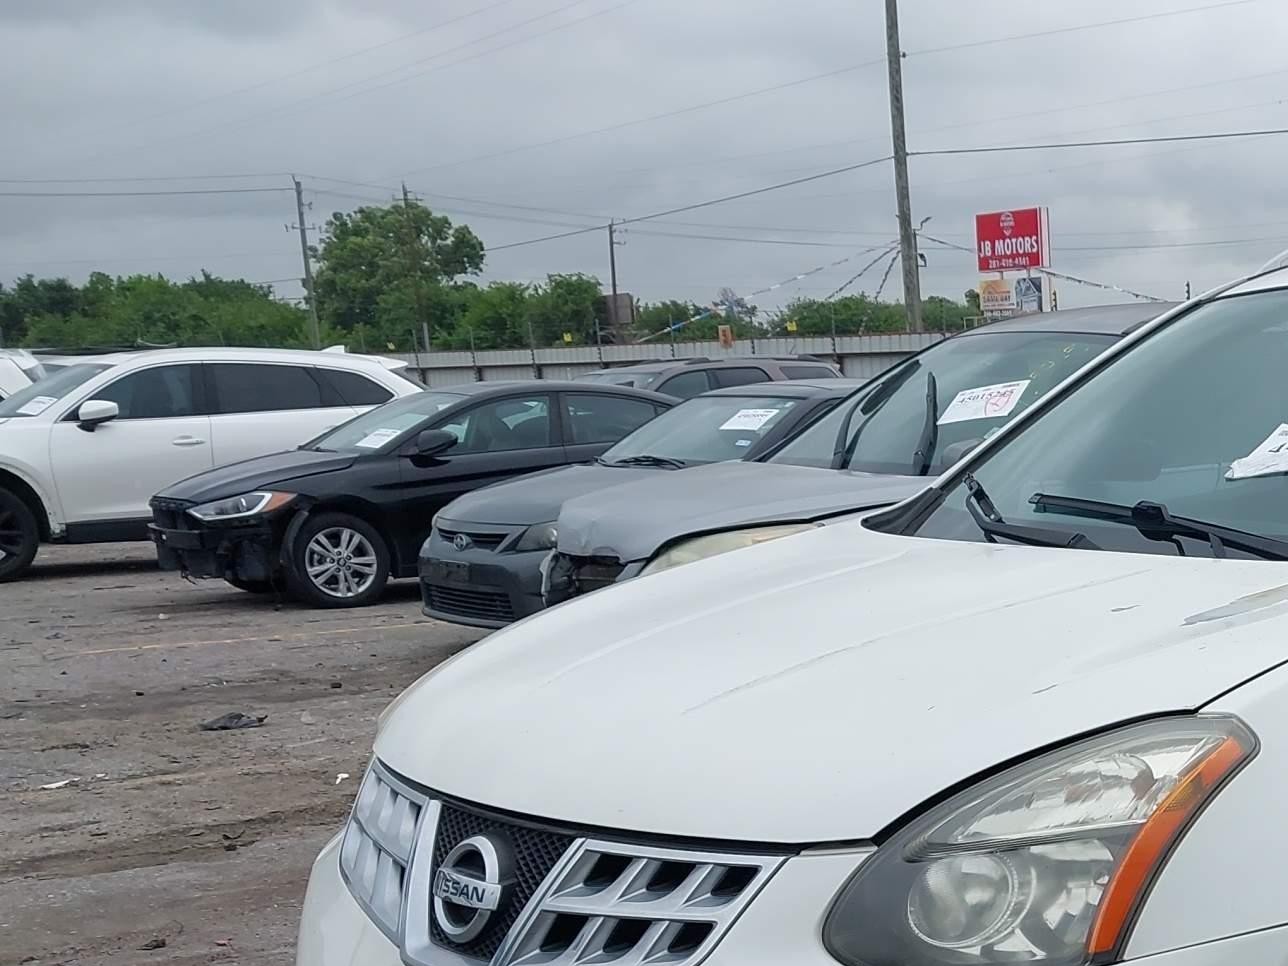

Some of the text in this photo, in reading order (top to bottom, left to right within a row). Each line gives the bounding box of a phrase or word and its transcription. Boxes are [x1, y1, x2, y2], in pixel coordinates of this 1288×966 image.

[980, 236, 1038, 257] JB MOTORS
[436, 870, 487, 904] NISSAN
